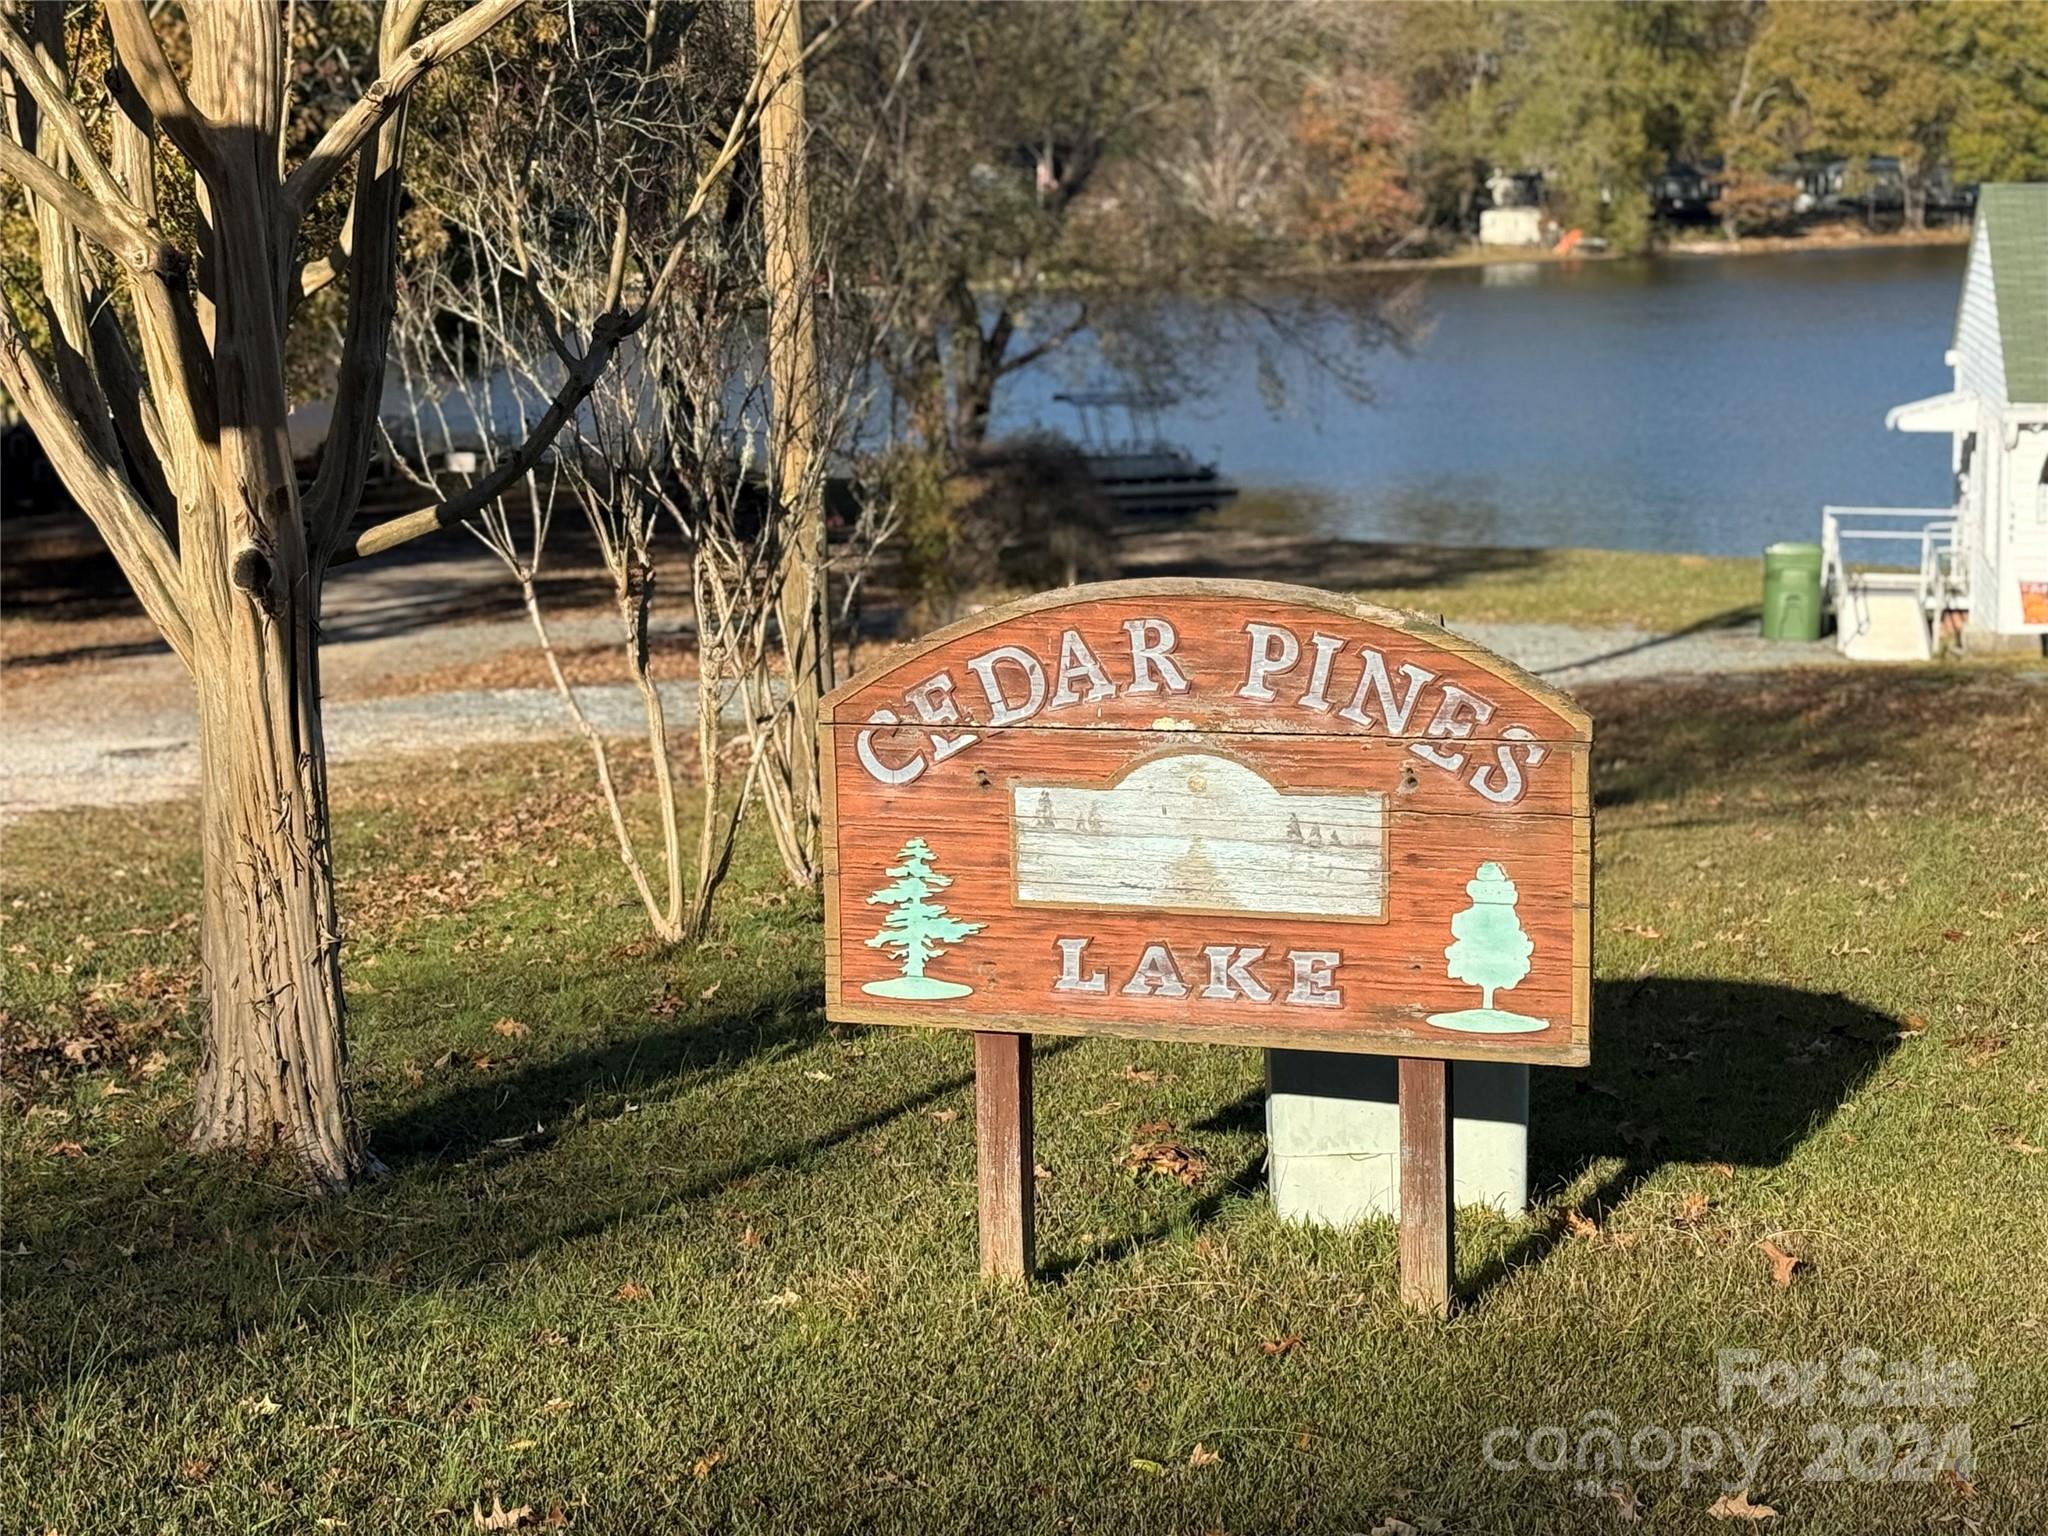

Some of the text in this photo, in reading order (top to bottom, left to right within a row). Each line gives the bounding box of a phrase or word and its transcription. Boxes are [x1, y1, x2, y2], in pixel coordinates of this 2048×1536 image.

[855, 617, 1549, 804] CEDAR PINES
[1053, 937, 1343, 1007] LAKE
